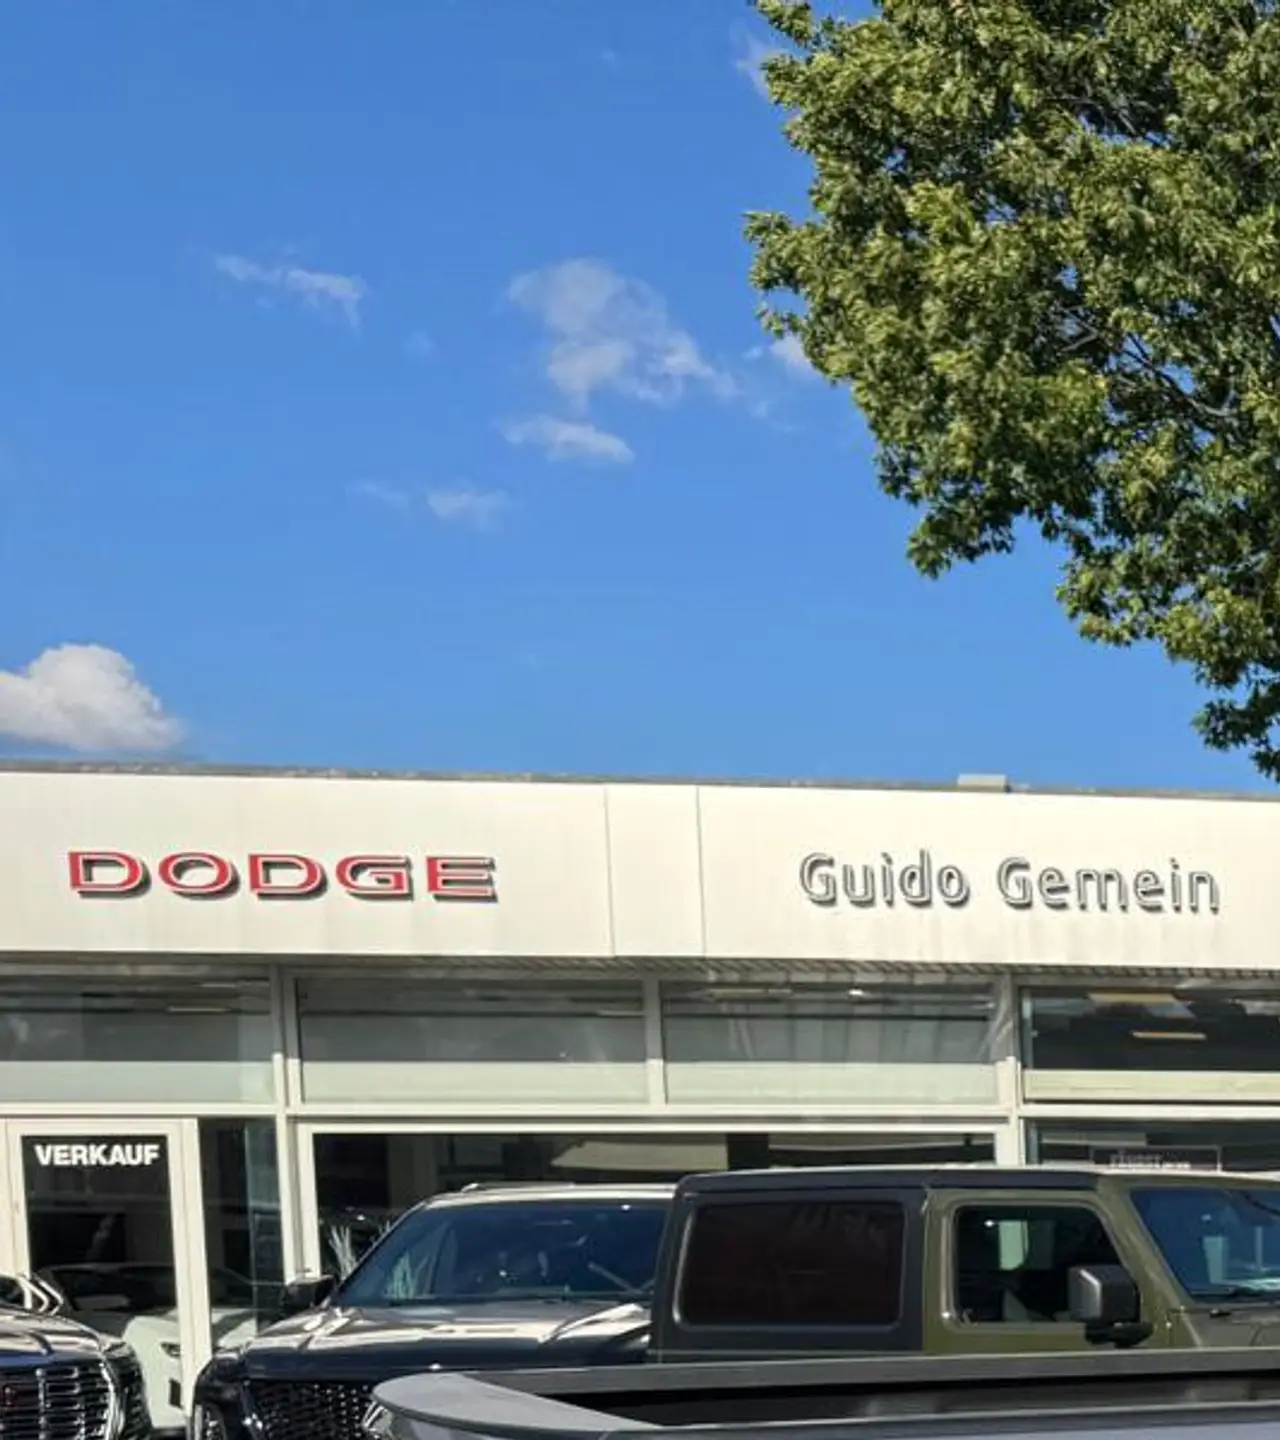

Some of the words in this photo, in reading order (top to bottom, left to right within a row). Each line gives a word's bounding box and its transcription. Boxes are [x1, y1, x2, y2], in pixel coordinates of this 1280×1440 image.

[67, 851, 498, 902] DODGE
[799, 849, 970, 908] Guido
[997, 857, 1221, 915] Gemein
[33, 1143, 161, 1167] VERKAUF
